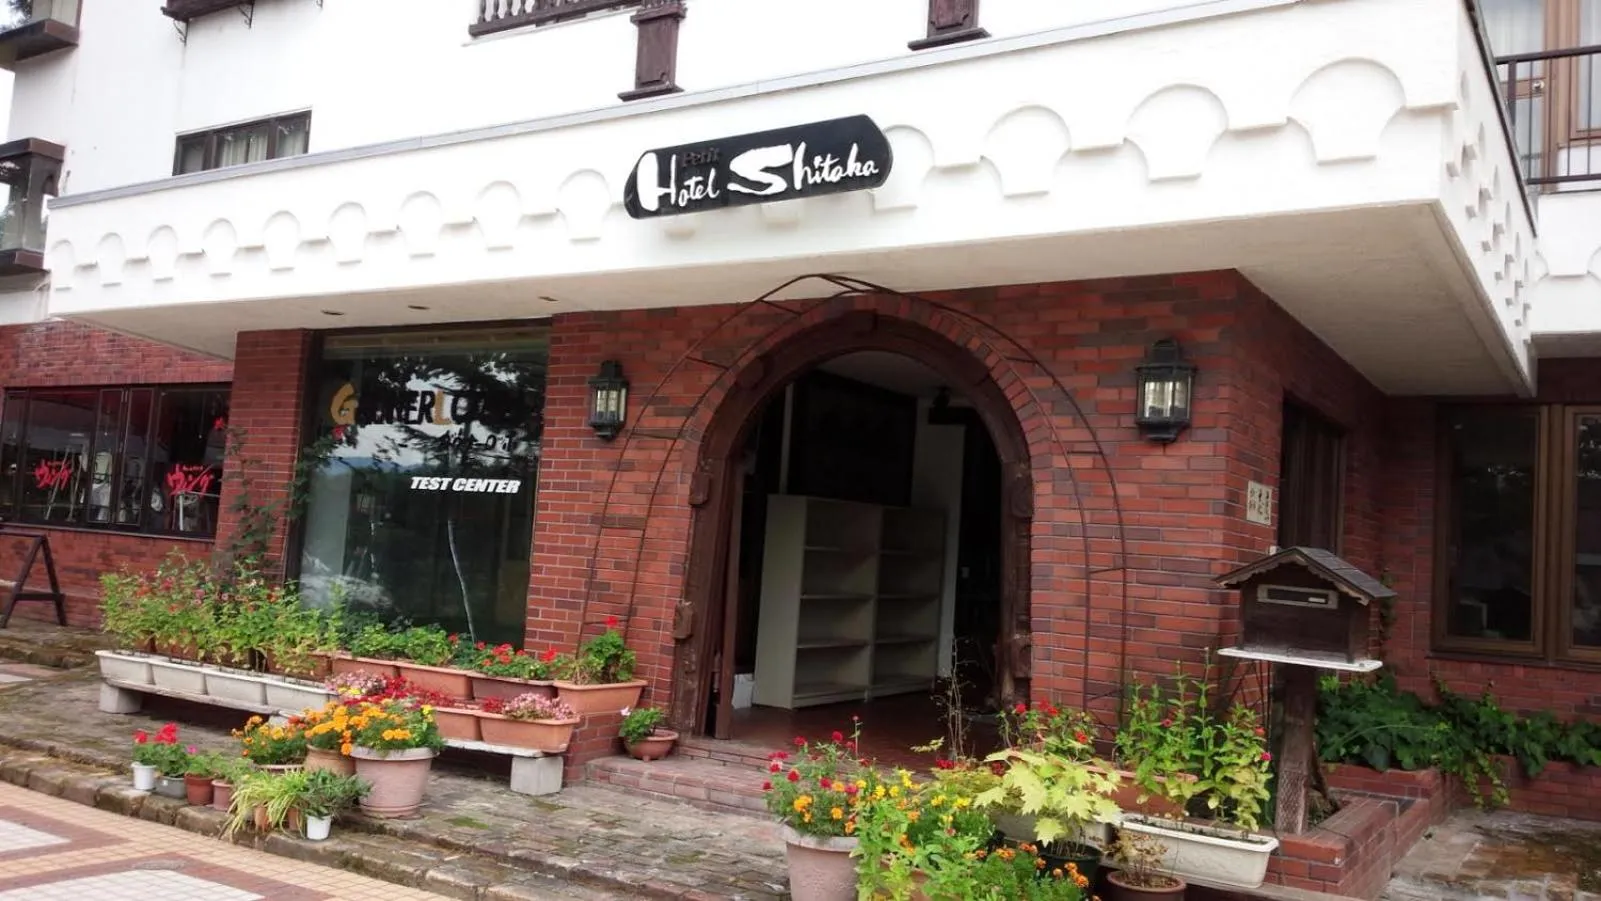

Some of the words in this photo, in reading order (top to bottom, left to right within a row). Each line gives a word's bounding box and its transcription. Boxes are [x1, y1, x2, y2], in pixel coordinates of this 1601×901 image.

[636, 151, 720, 212] Hotel
[726, 141, 879, 196] Shitaka
[410, 476, 452, 491] TEST
[452, 477, 522, 494] CENTER
